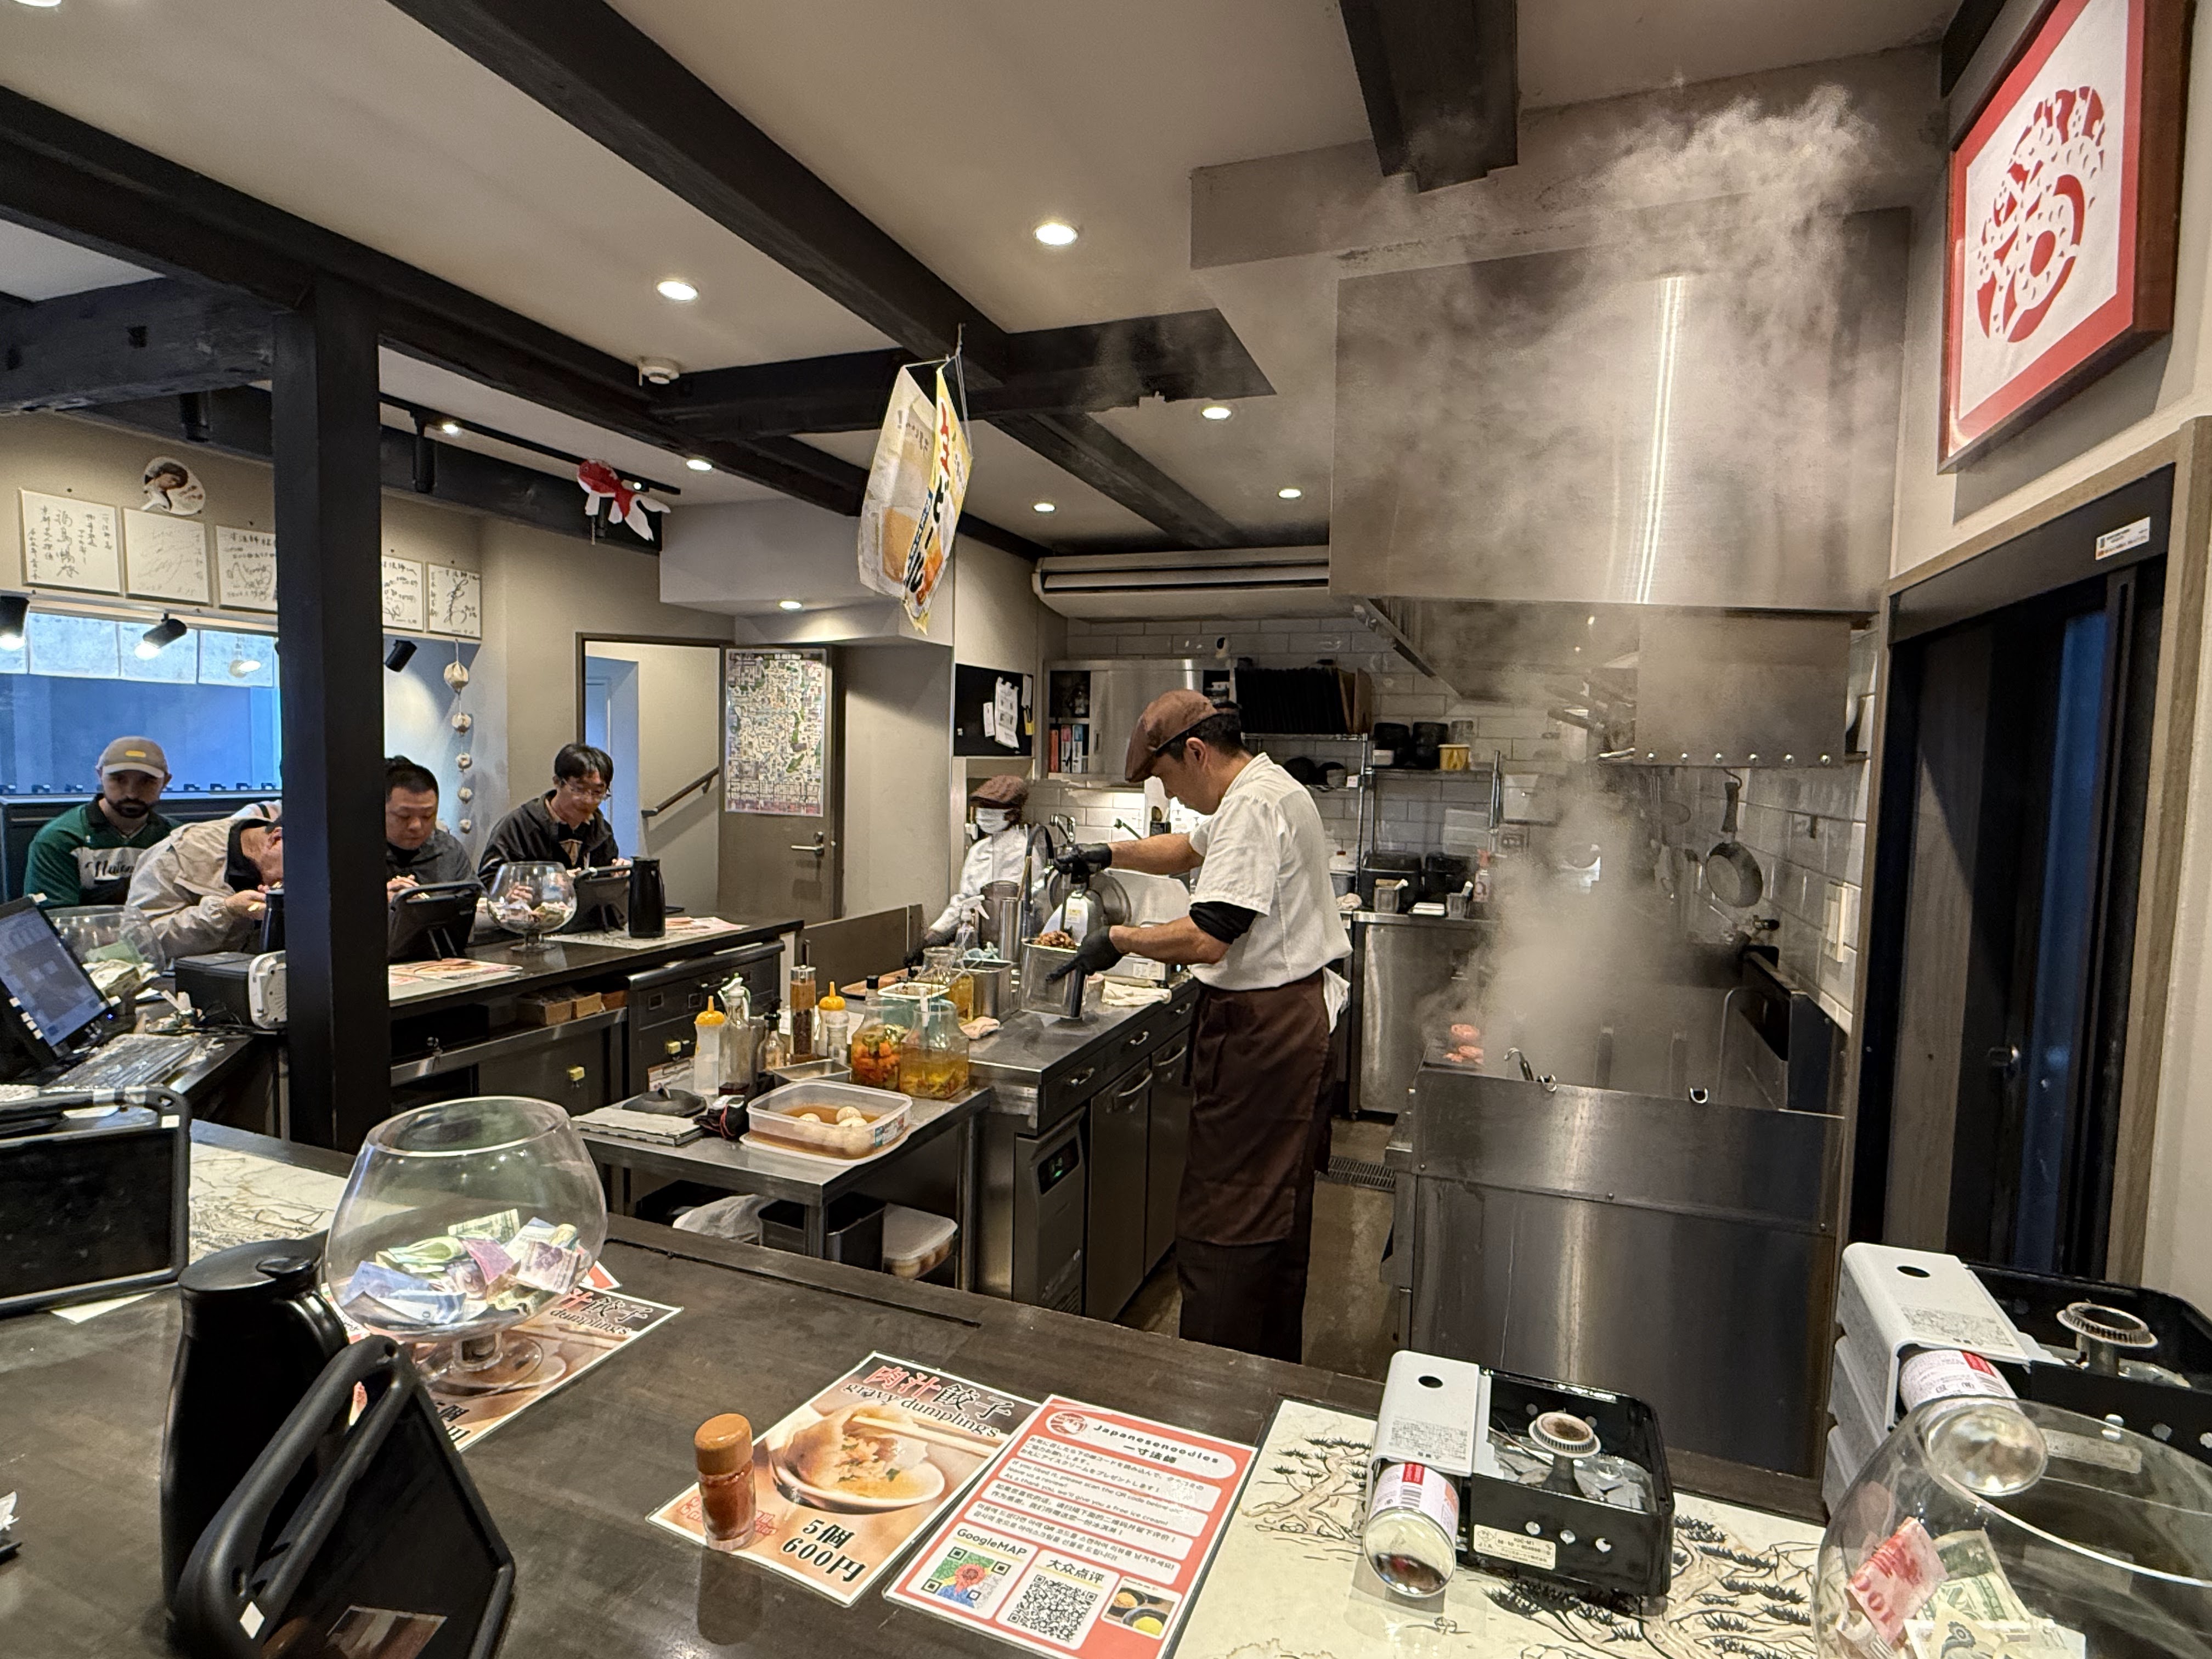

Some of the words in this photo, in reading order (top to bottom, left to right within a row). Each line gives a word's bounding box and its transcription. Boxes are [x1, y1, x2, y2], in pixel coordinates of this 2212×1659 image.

[550, 1308, 632, 1335] dumplings
[555, 1288, 653, 1323] 汁餃子
[865, 1365, 1014, 1419] 肉汁餃子
[844, 1382, 900, 1403] gravy
[900, 1396, 1001, 1438] dumplings
[1093, 1425, 1218, 1464] Japanesenoodles
[803, 1519, 855, 1549] 5個
[957, 1528, 1028, 1556] GoogleMAP
[783, 1537, 866, 1582] 600円
[1047, 1559, 1105, 1584] 大众点评
